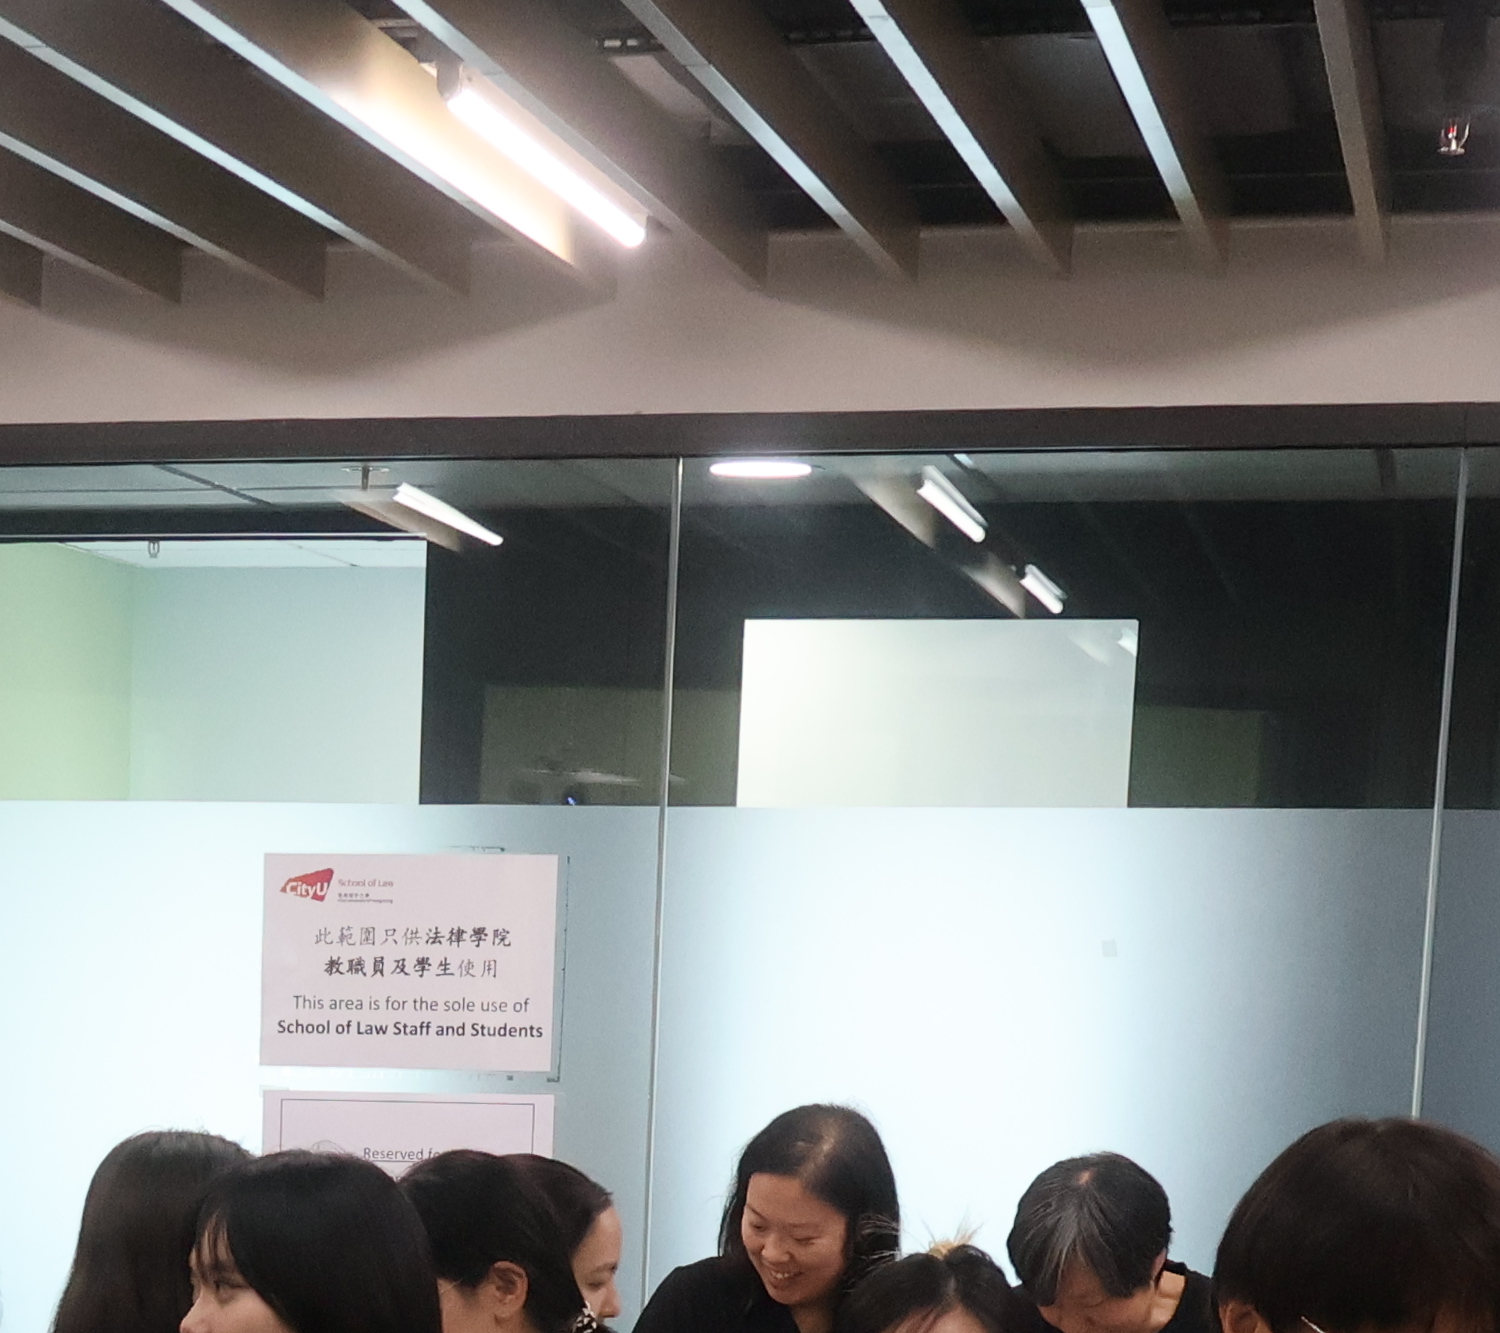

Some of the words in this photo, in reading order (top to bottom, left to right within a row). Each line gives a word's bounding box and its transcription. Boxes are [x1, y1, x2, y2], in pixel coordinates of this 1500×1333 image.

[286, 881, 329, 898] CityU
[314, 925, 512, 948] 此範圍只供法律學院
[323, 955, 499, 978] 教職員及學生使用
[292, 994, 325, 1010] This
[328, 998, 364, 1011] area
[368, 995, 381, 1011] is
[385, 995, 409, 1011] for
[412, 996, 439, 1012] the
[443, 997, 476, 1012] sole
[480, 999, 509, 1013] use
[512, 997, 531, 1013] of
[277, 1019, 331, 1035] School
[335, 1020, 353, 1035] of
[356, 1021, 389, 1036] Law
[392, 1020, 432, 1036] Staff
[435, 1022, 466, 1037] and
[470, 1022, 544, 1038] Students
[363, 1147, 424, 1161] Reserved
